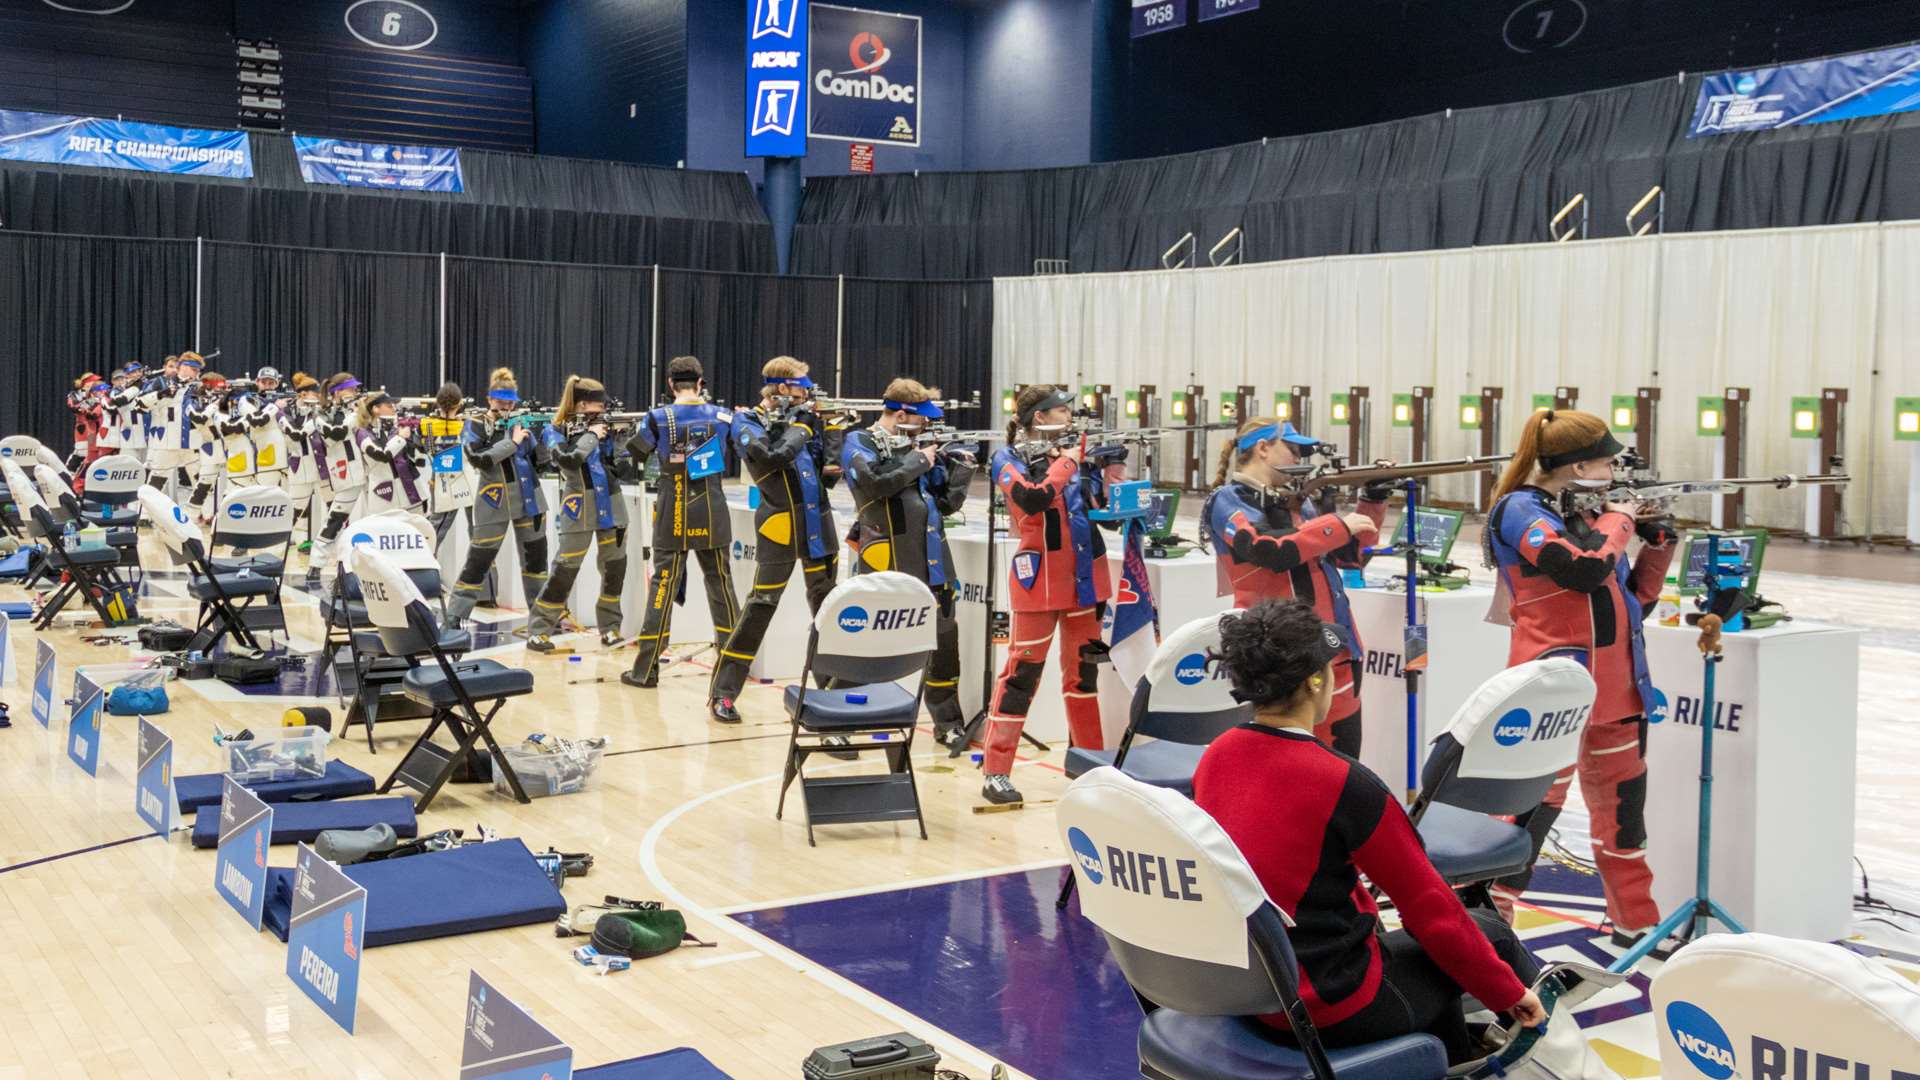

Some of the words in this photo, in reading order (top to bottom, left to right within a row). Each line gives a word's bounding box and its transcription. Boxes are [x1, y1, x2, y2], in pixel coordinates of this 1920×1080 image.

[382, 12, 402, 36] 6
[1144, 4, 1175, 26] 1958
[751, 51, 799, 69] NCAA
[815, 68, 914, 104] ComDoc
[69, 135, 115, 154] RIFLE
[116, 140, 245, 165] CHAMPIONSHIPS
[110, 470, 140, 480] RIFLE
[250, 504, 288, 518] RIFLE
[379, 534, 424, 550] RIFLE
[687, 528, 709, 537] USA
[963, 583, 986, 604] RIFL
[840, 618, 868, 627] NCAA
[872, 606, 930, 631] RIFLE
[1366, 650, 1407, 679] RIFL
[1495, 724, 1529, 738] NCAA
[1531, 704, 1590, 742] RIFLE
[1673, 695, 1744, 732] RILE
[1075, 850, 1106, 875] NCAA
[1106, 845, 1203, 902] RIFLE
[299, 944, 339, 1005] PEREIRA
[1676, 1029, 1737, 1073] NCAA
[1751, 1034, 1920, 1080] RIF
